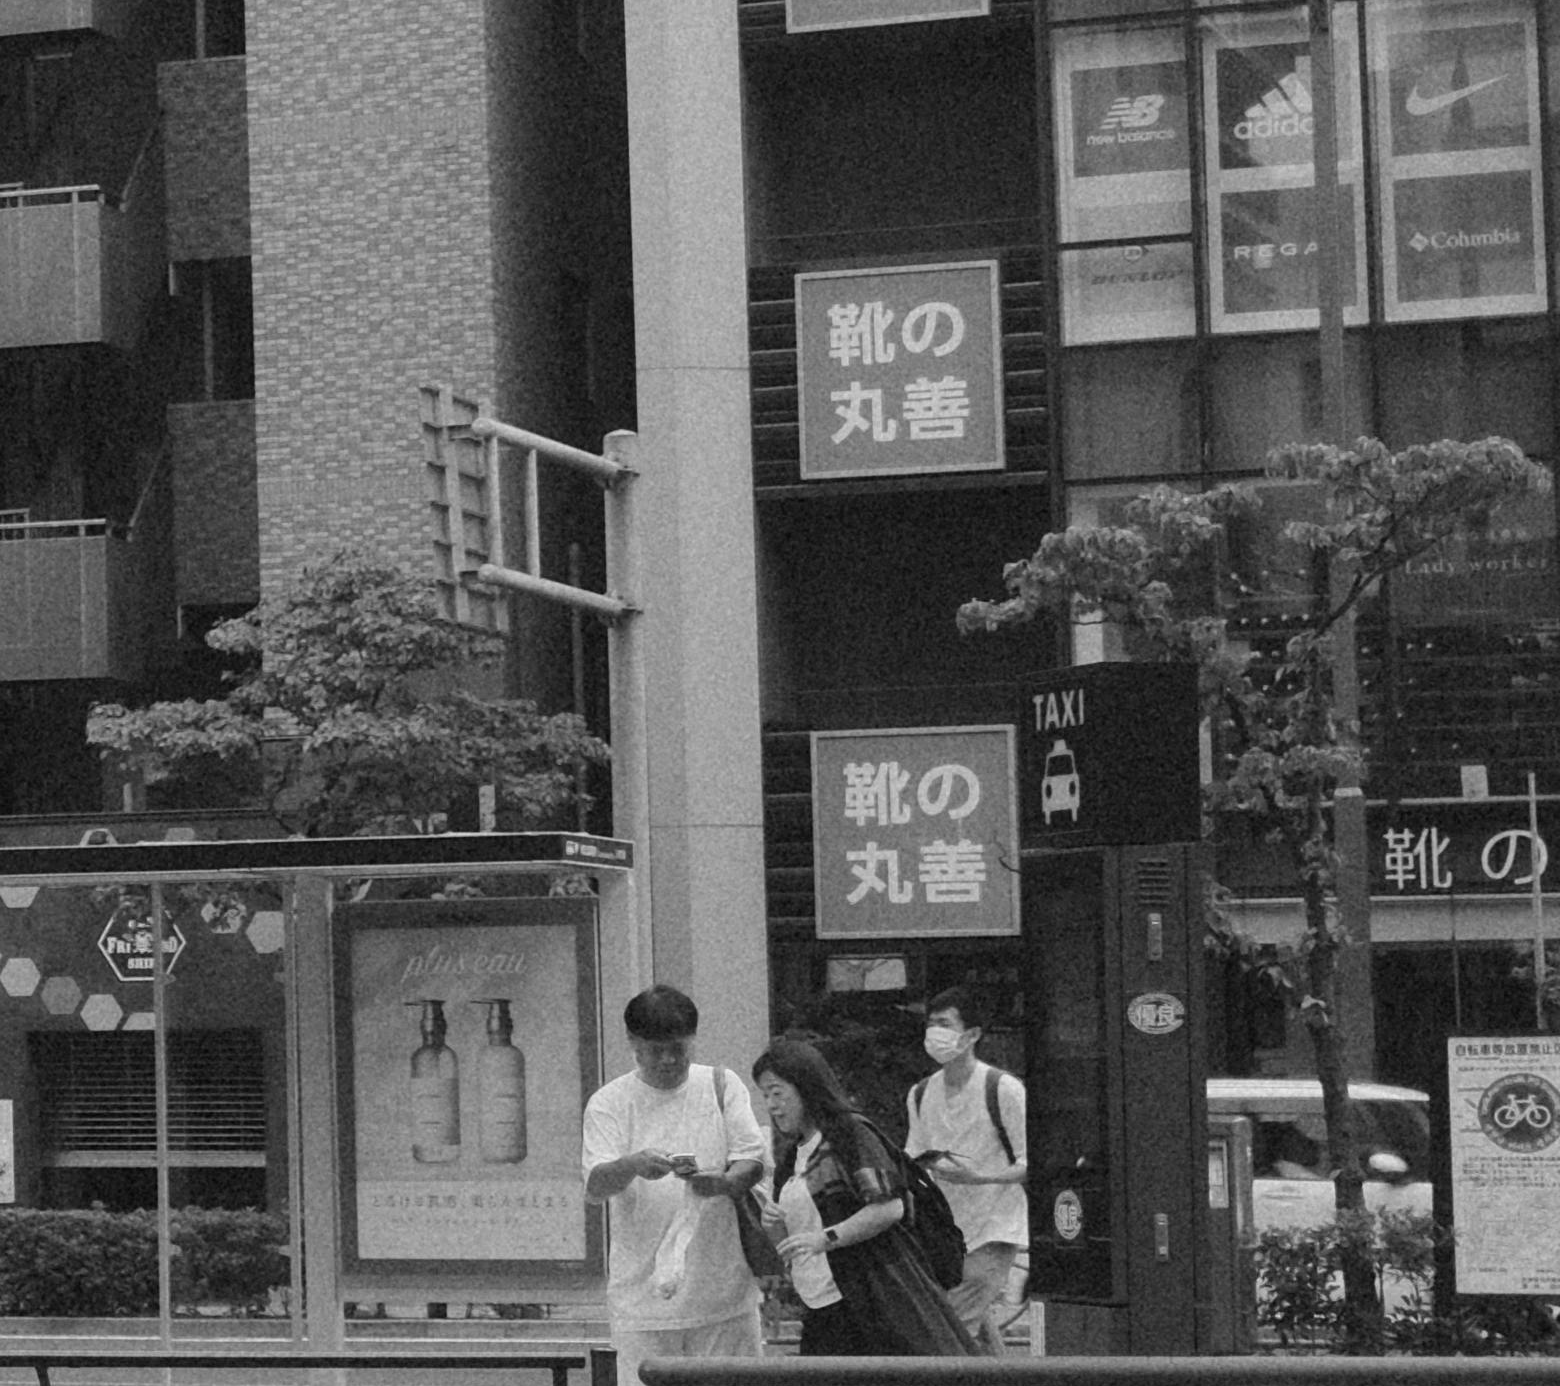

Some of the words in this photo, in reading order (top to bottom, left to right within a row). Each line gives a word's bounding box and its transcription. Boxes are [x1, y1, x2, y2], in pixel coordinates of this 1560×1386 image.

[1086, 133, 1115, 146] new
[1118, 127, 1178, 145] balance
[1430, 228, 1522, 250] Columbia
[827, 301, 966, 367] 靴の
[830, 377, 970, 445] 丸善
[1032, 689, 1085, 731] TAXI
[843, 760, 981, 828] 靴の
[845, 839, 987, 907] 丸善
